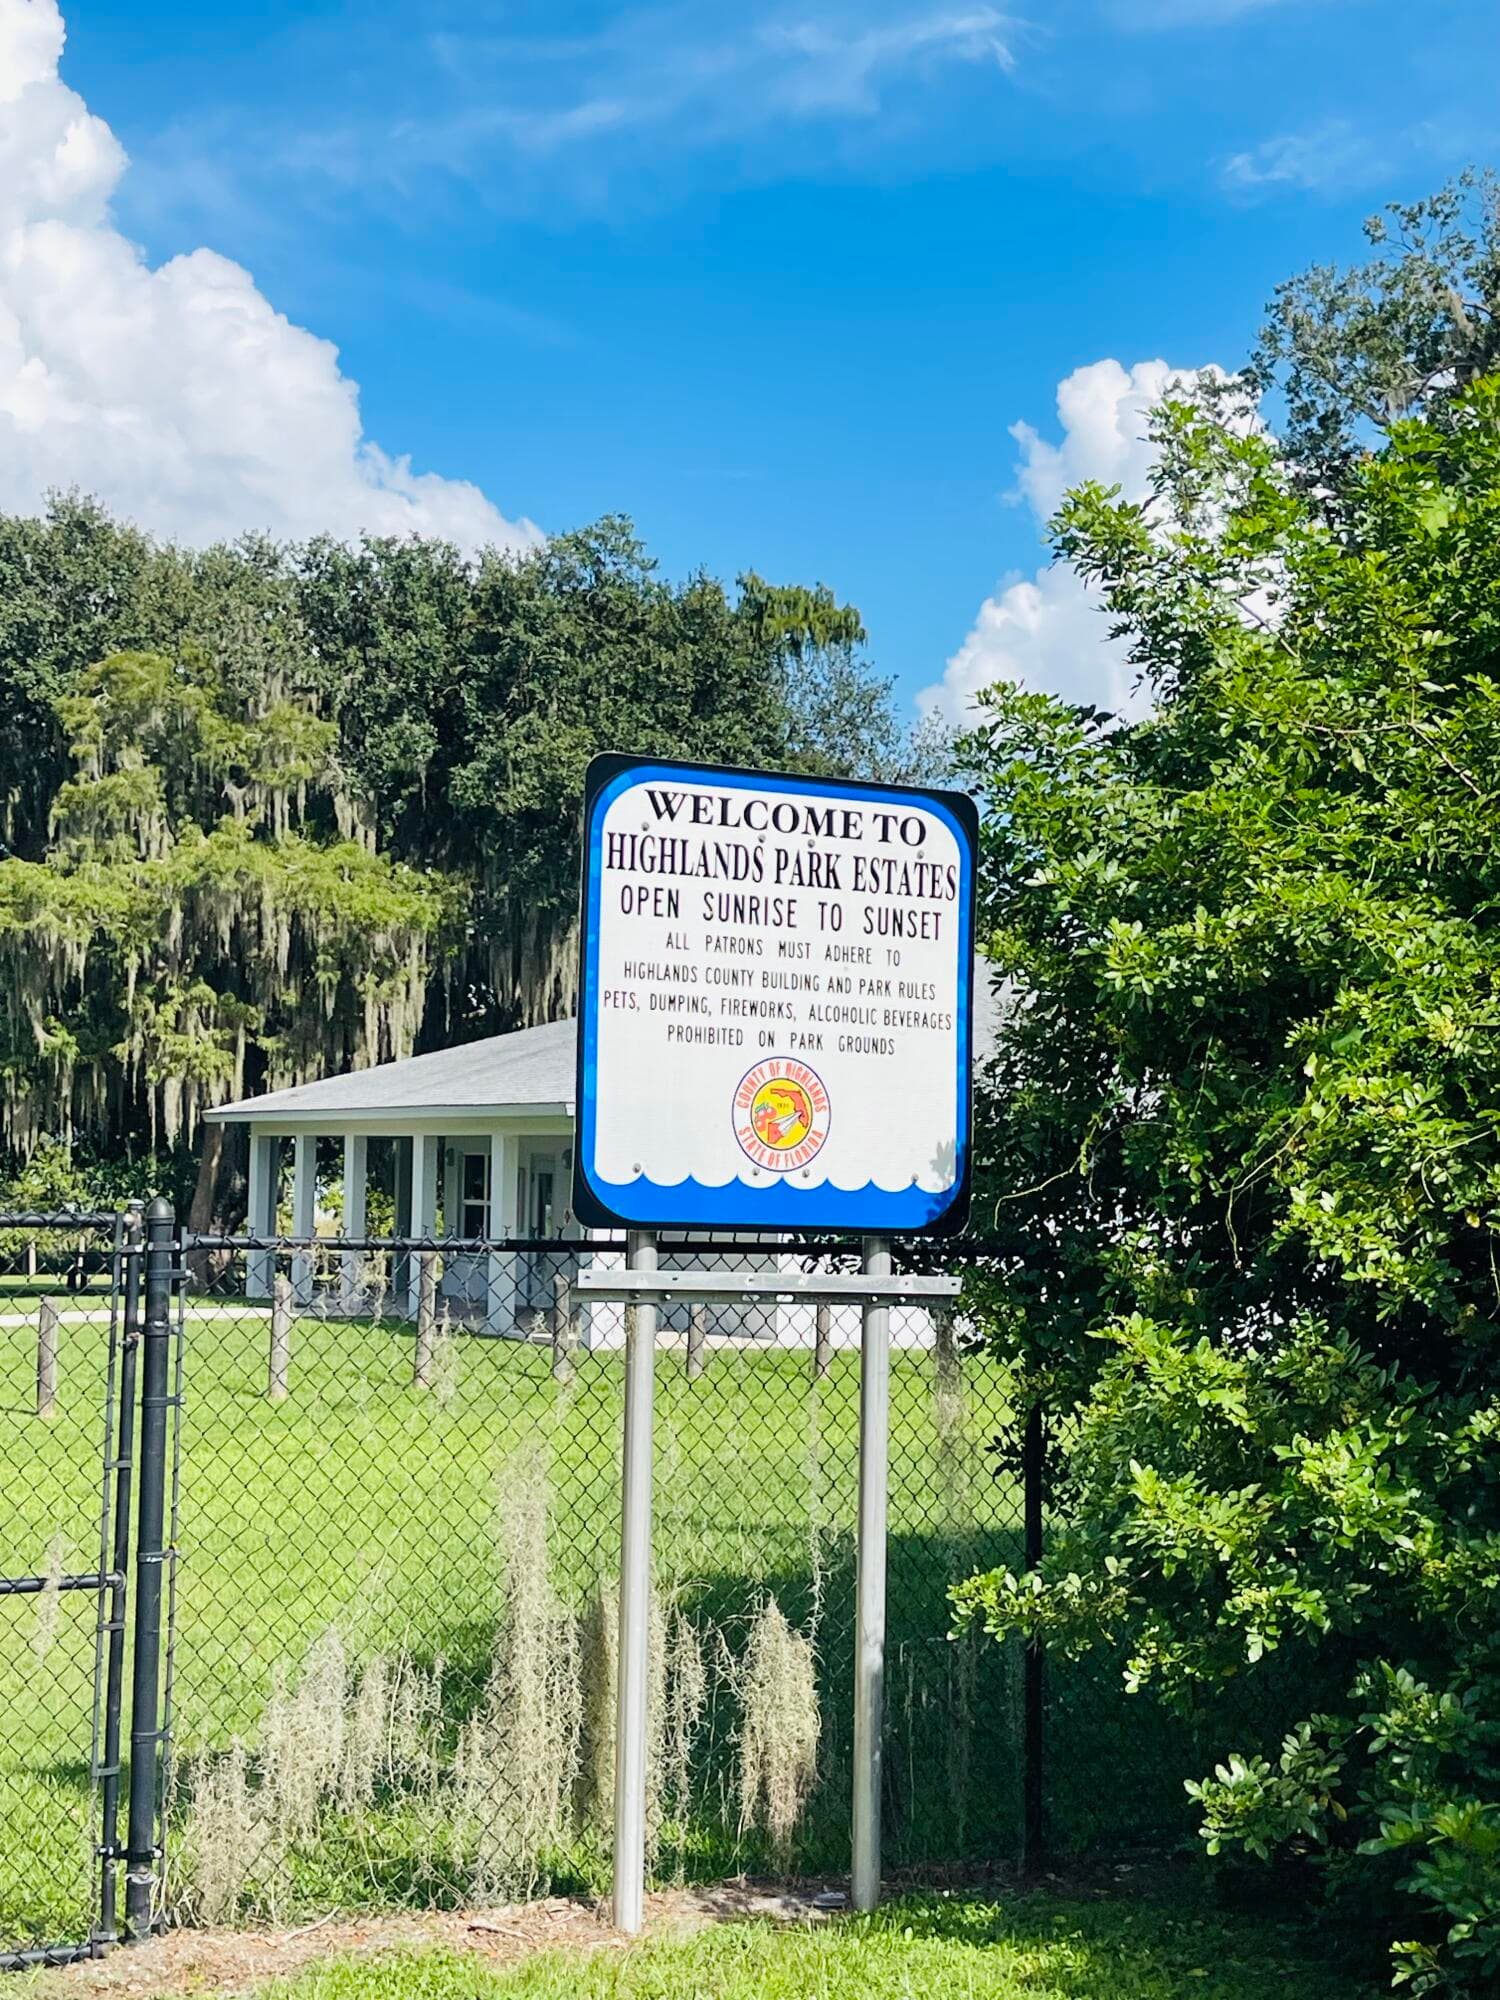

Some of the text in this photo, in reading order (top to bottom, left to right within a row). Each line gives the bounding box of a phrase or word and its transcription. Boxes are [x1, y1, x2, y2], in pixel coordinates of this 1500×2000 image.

[645, 789, 926, 847] WELCOME TO
[605, 832, 956, 901] HIGHLANDS PARK ESTATES
[621, 884, 942, 940] OPEN SUNRISE TO SUNSET
[666, 933, 900, 966] ALL PATRONS MUST ADHERE TO
[624, 961, 936, 1001] HIGHLANDS COUNTY BUILDING AND PARK RULES
[604, 991, 952, 1030] PETS, DUMPING, FIREWORKS, ALCOHOLIC BEVERAGES
[667, 1024, 895, 1055] PROHIBITED ON PARK GROUNDS
[736, 1062, 827, 1112] COUNTY OF HIGHLANDS
[739, 1126, 824, 1168] STATE OF FLORIDA
